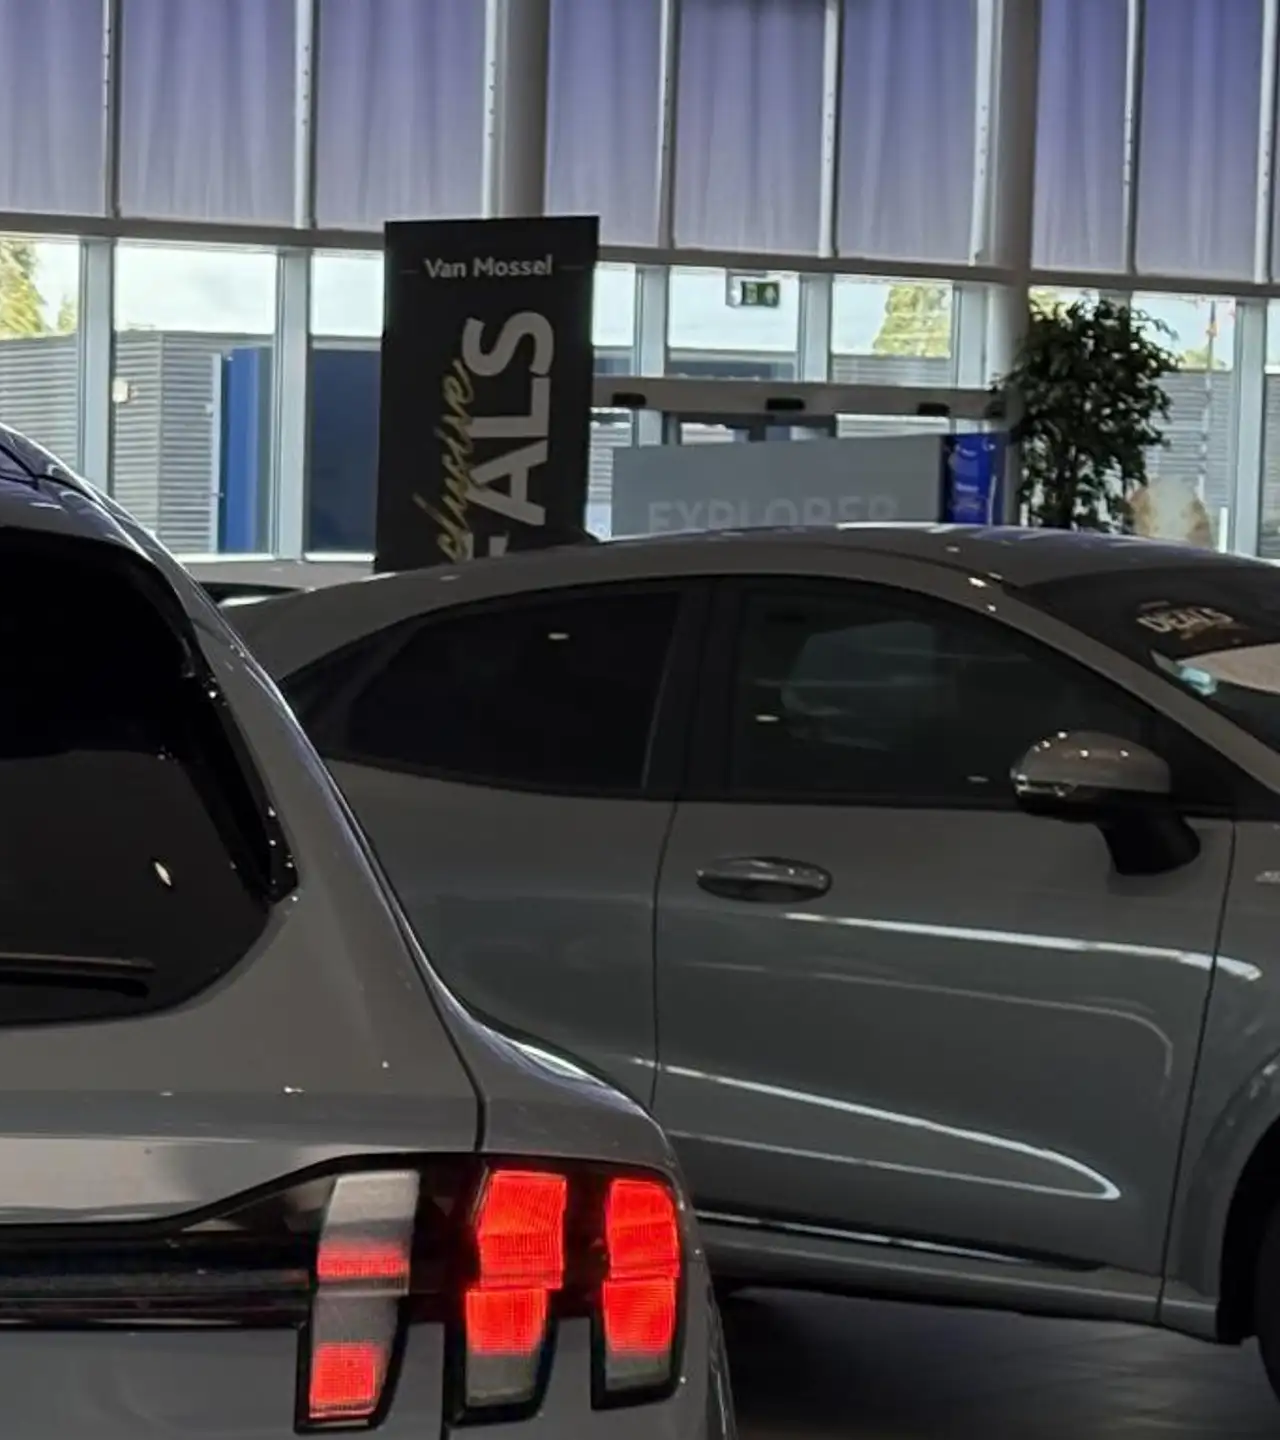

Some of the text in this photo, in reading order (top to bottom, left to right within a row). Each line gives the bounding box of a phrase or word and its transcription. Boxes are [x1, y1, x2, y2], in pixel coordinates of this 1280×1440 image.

[424, 254, 553, 278] Van Mossel
[462, 311, 554, 559] ALS
